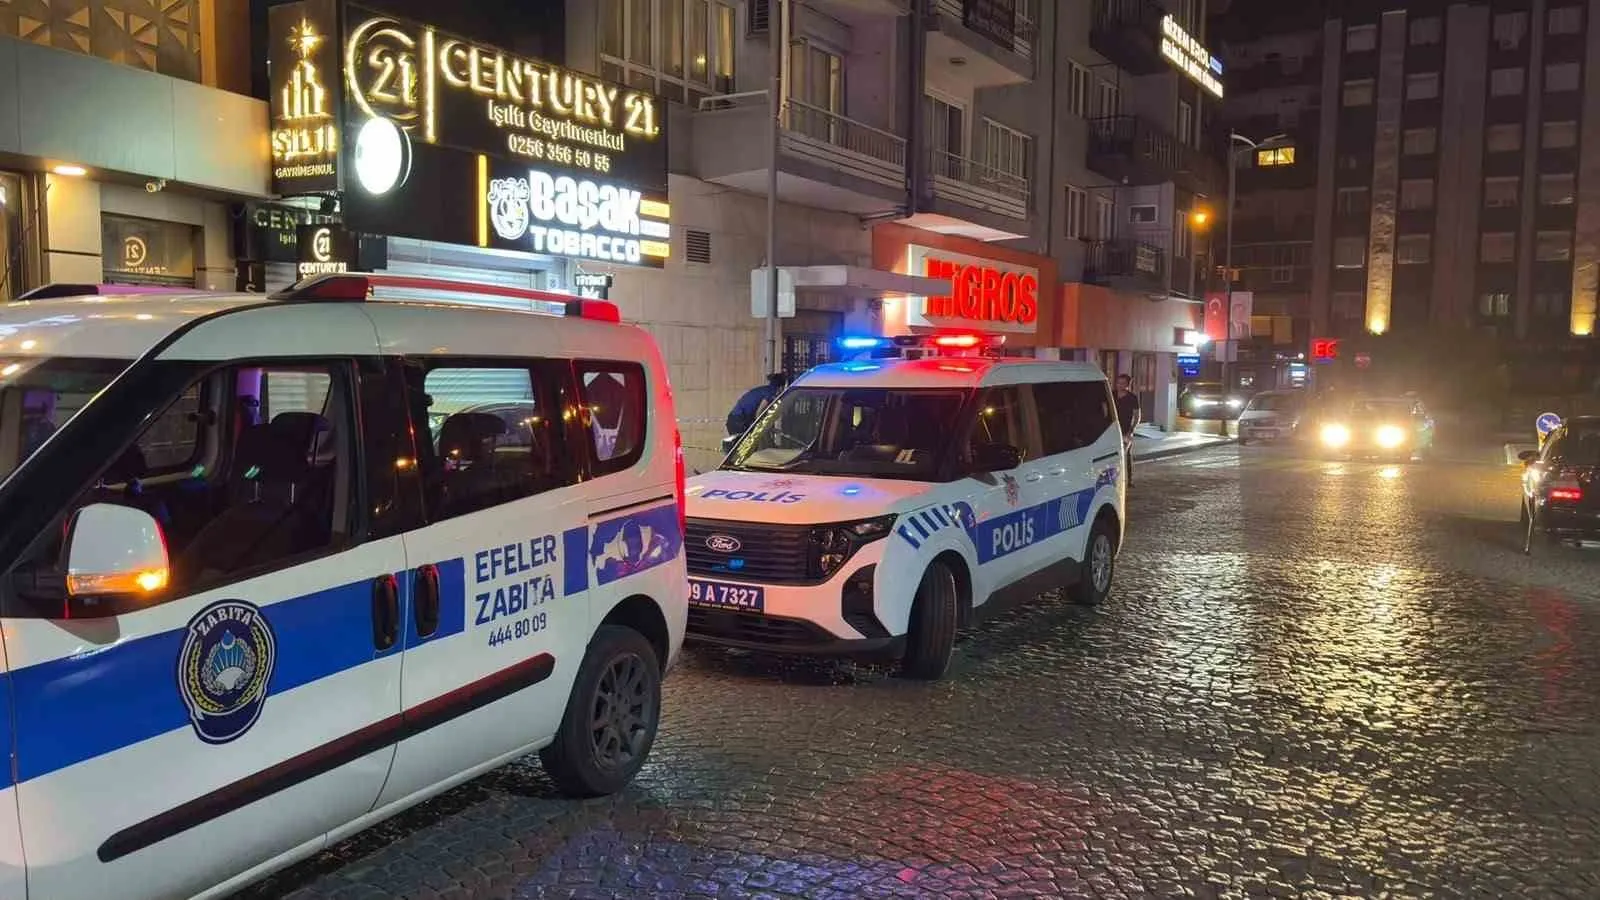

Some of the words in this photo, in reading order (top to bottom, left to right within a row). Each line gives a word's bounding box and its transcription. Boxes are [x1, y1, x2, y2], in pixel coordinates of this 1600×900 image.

[369, 46, 417, 105] 21
[440, 40, 618, 126] CENTURY
[624, 91, 659, 136] 21
[528, 109, 625, 151] Gayrimenkul
[508, 133, 544, 159] 0256
[547, 142, 572, 163] 356
[575, 149, 591, 168] 50
[594, 154, 611, 173] 55
[319, 237, 331, 253] 21
[530, 226, 641, 263] TOBACCO
[299, 262, 337, 274] CENTURY
[992, 511, 1035, 556] POLİS
[475, 534, 558, 584] EFELER
[474, 574, 556, 627] ZABITA
[705, 584, 716, 601] A
[719, 586, 759, 607] 7327
[196, 606, 252, 637] ZABITA
[488, 623, 514, 648] 444
[514, 618, 531, 640] 80
[531, 612, 548, 633] 09
